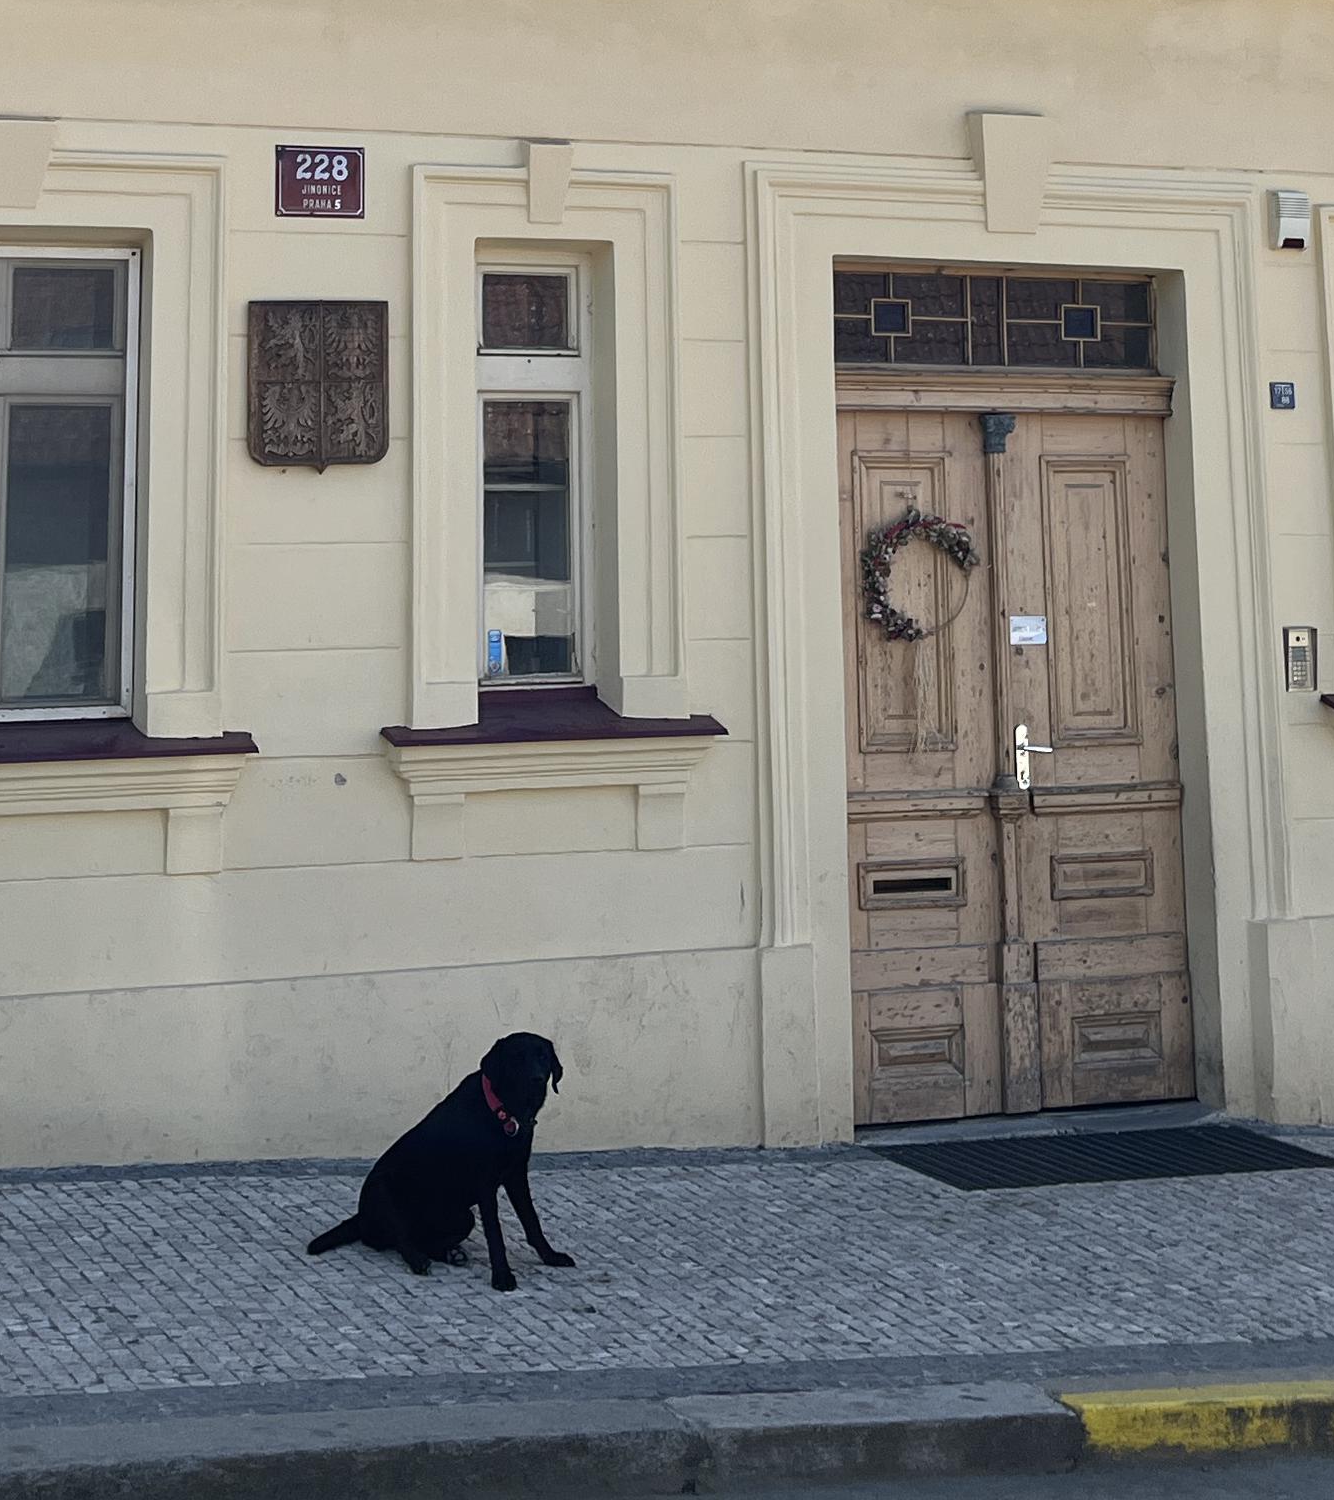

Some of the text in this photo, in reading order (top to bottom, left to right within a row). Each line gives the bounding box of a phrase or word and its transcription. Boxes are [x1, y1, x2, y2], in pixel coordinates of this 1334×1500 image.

[296, 153, 348, 181] 228
[301, 185, 342, 195] JINONICE
[303, 199, 341, 210] PRAHA 5
